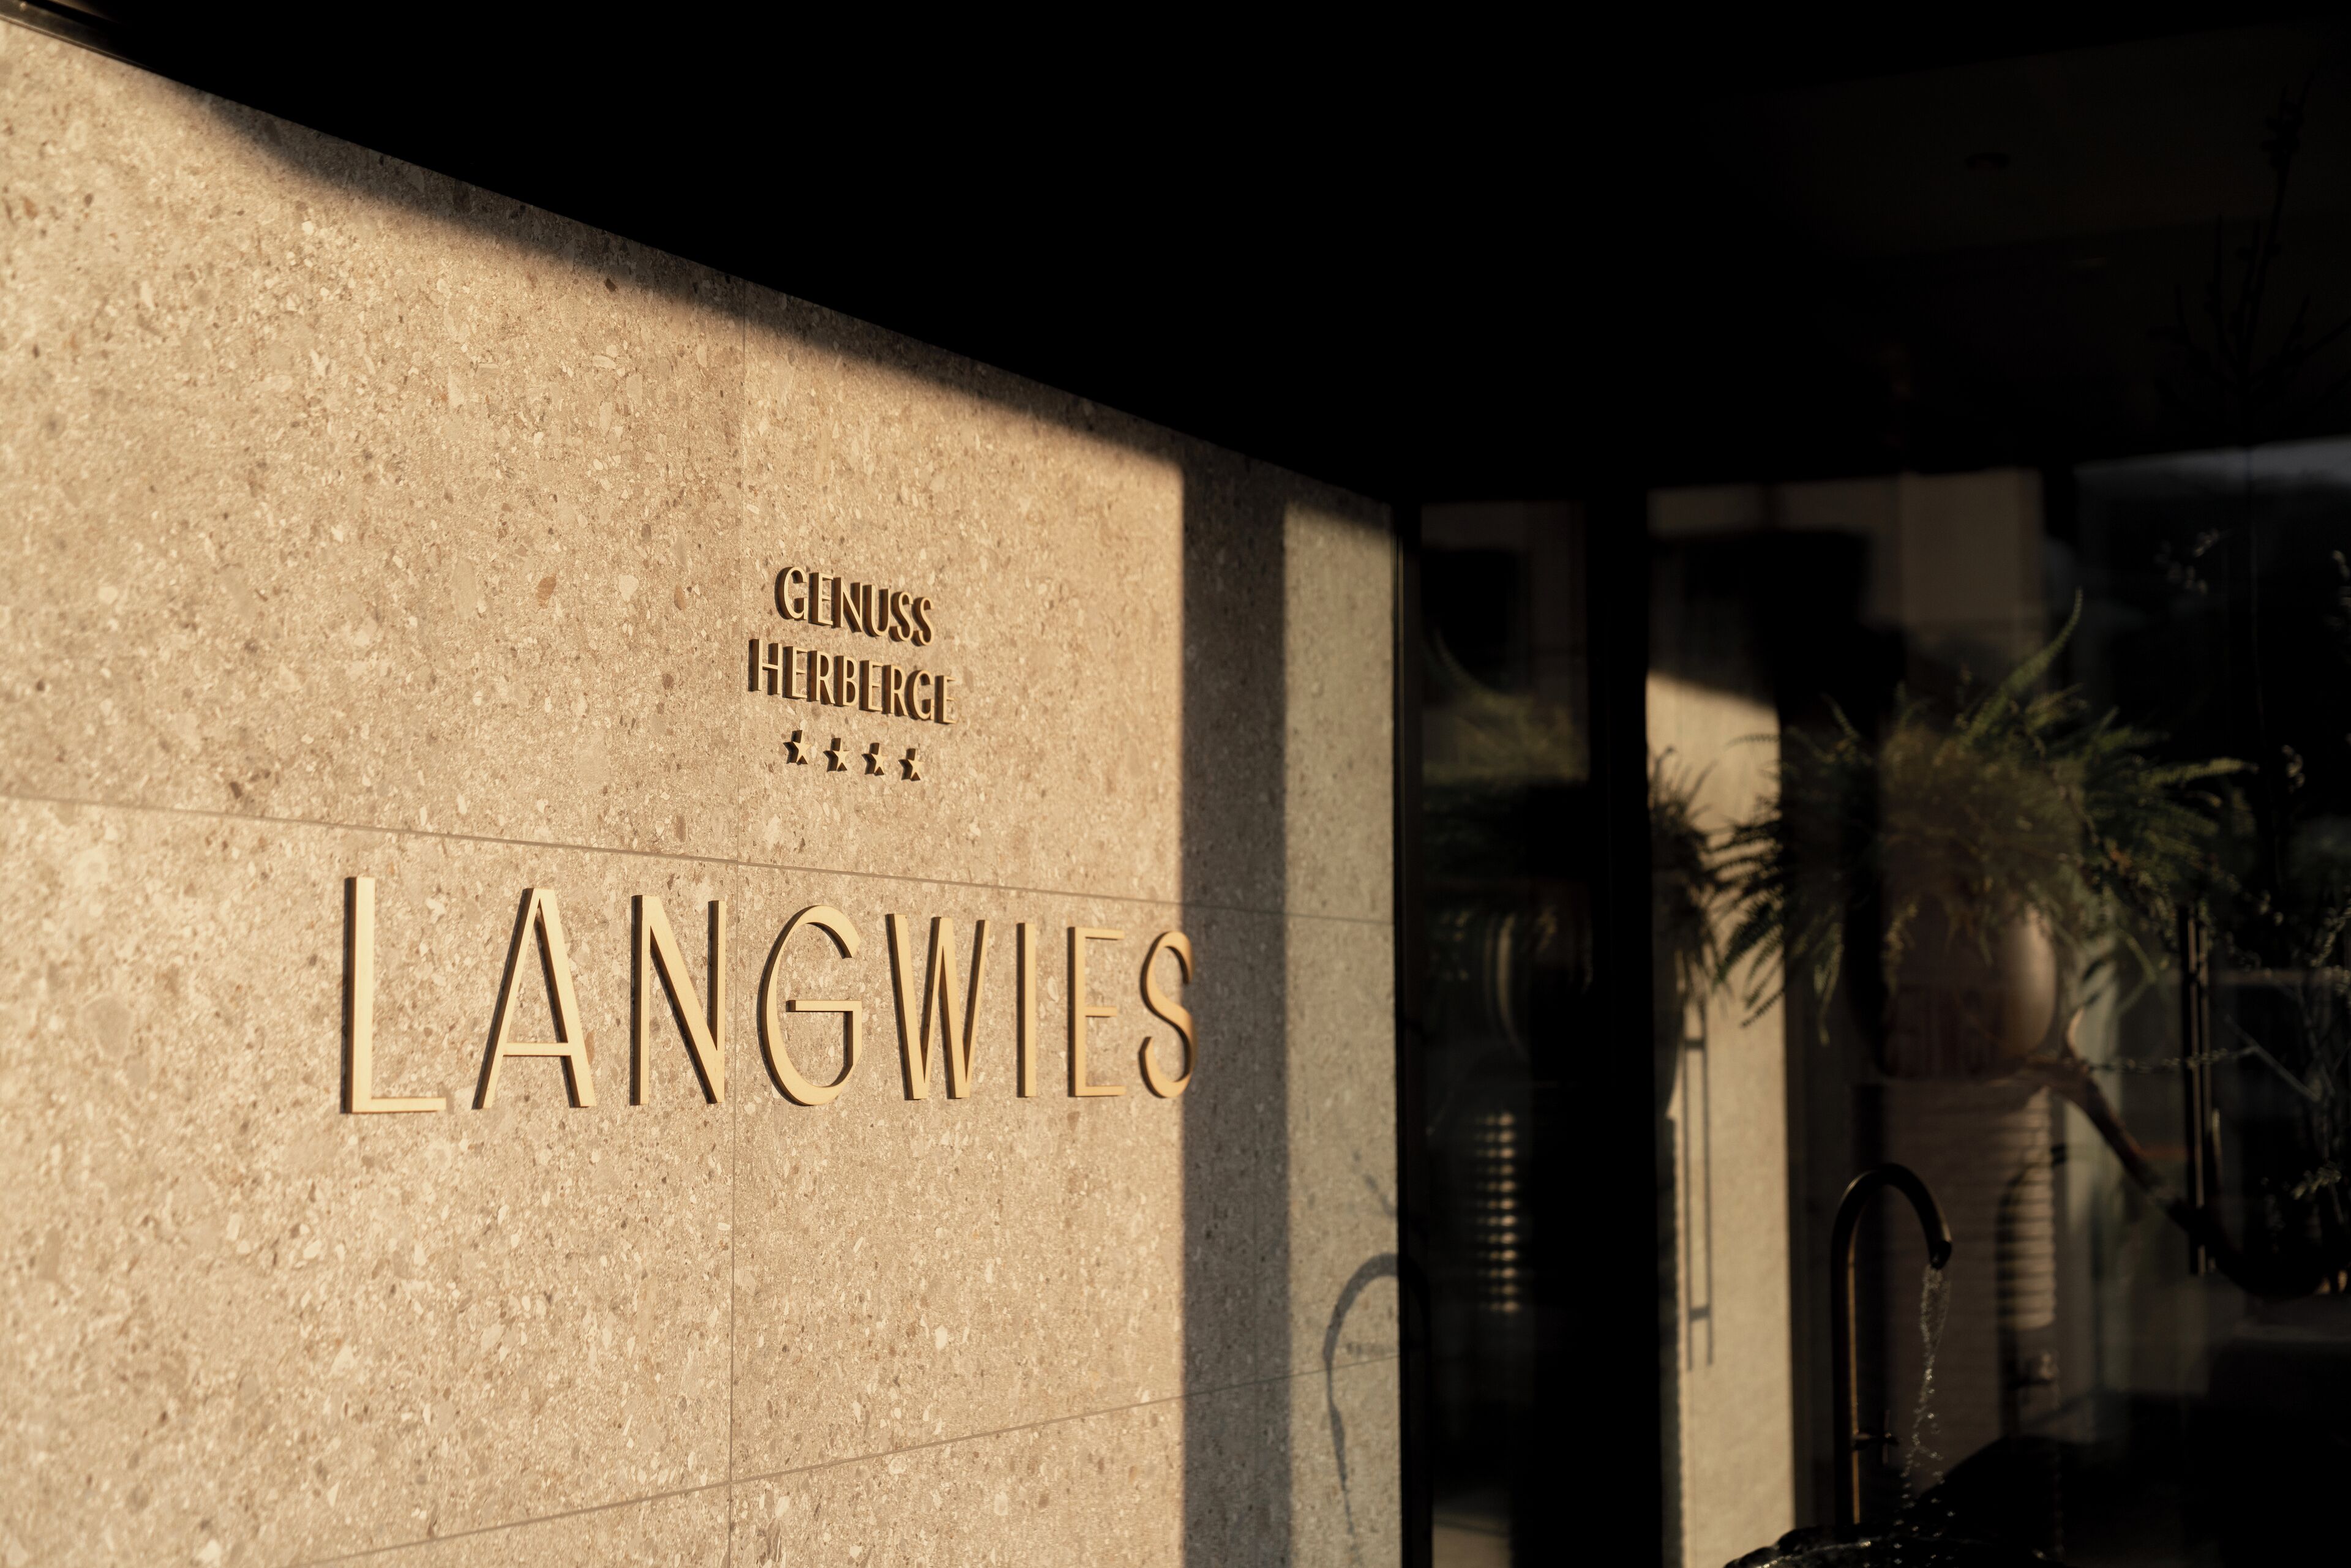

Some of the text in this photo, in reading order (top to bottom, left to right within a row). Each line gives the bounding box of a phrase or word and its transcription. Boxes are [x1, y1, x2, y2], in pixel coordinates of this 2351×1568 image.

[775, 566, 935, 647] GENUSS
[748, 639, 956, 725] HERBERGE
[341, 876, 1196, 1114] LANGWIES
